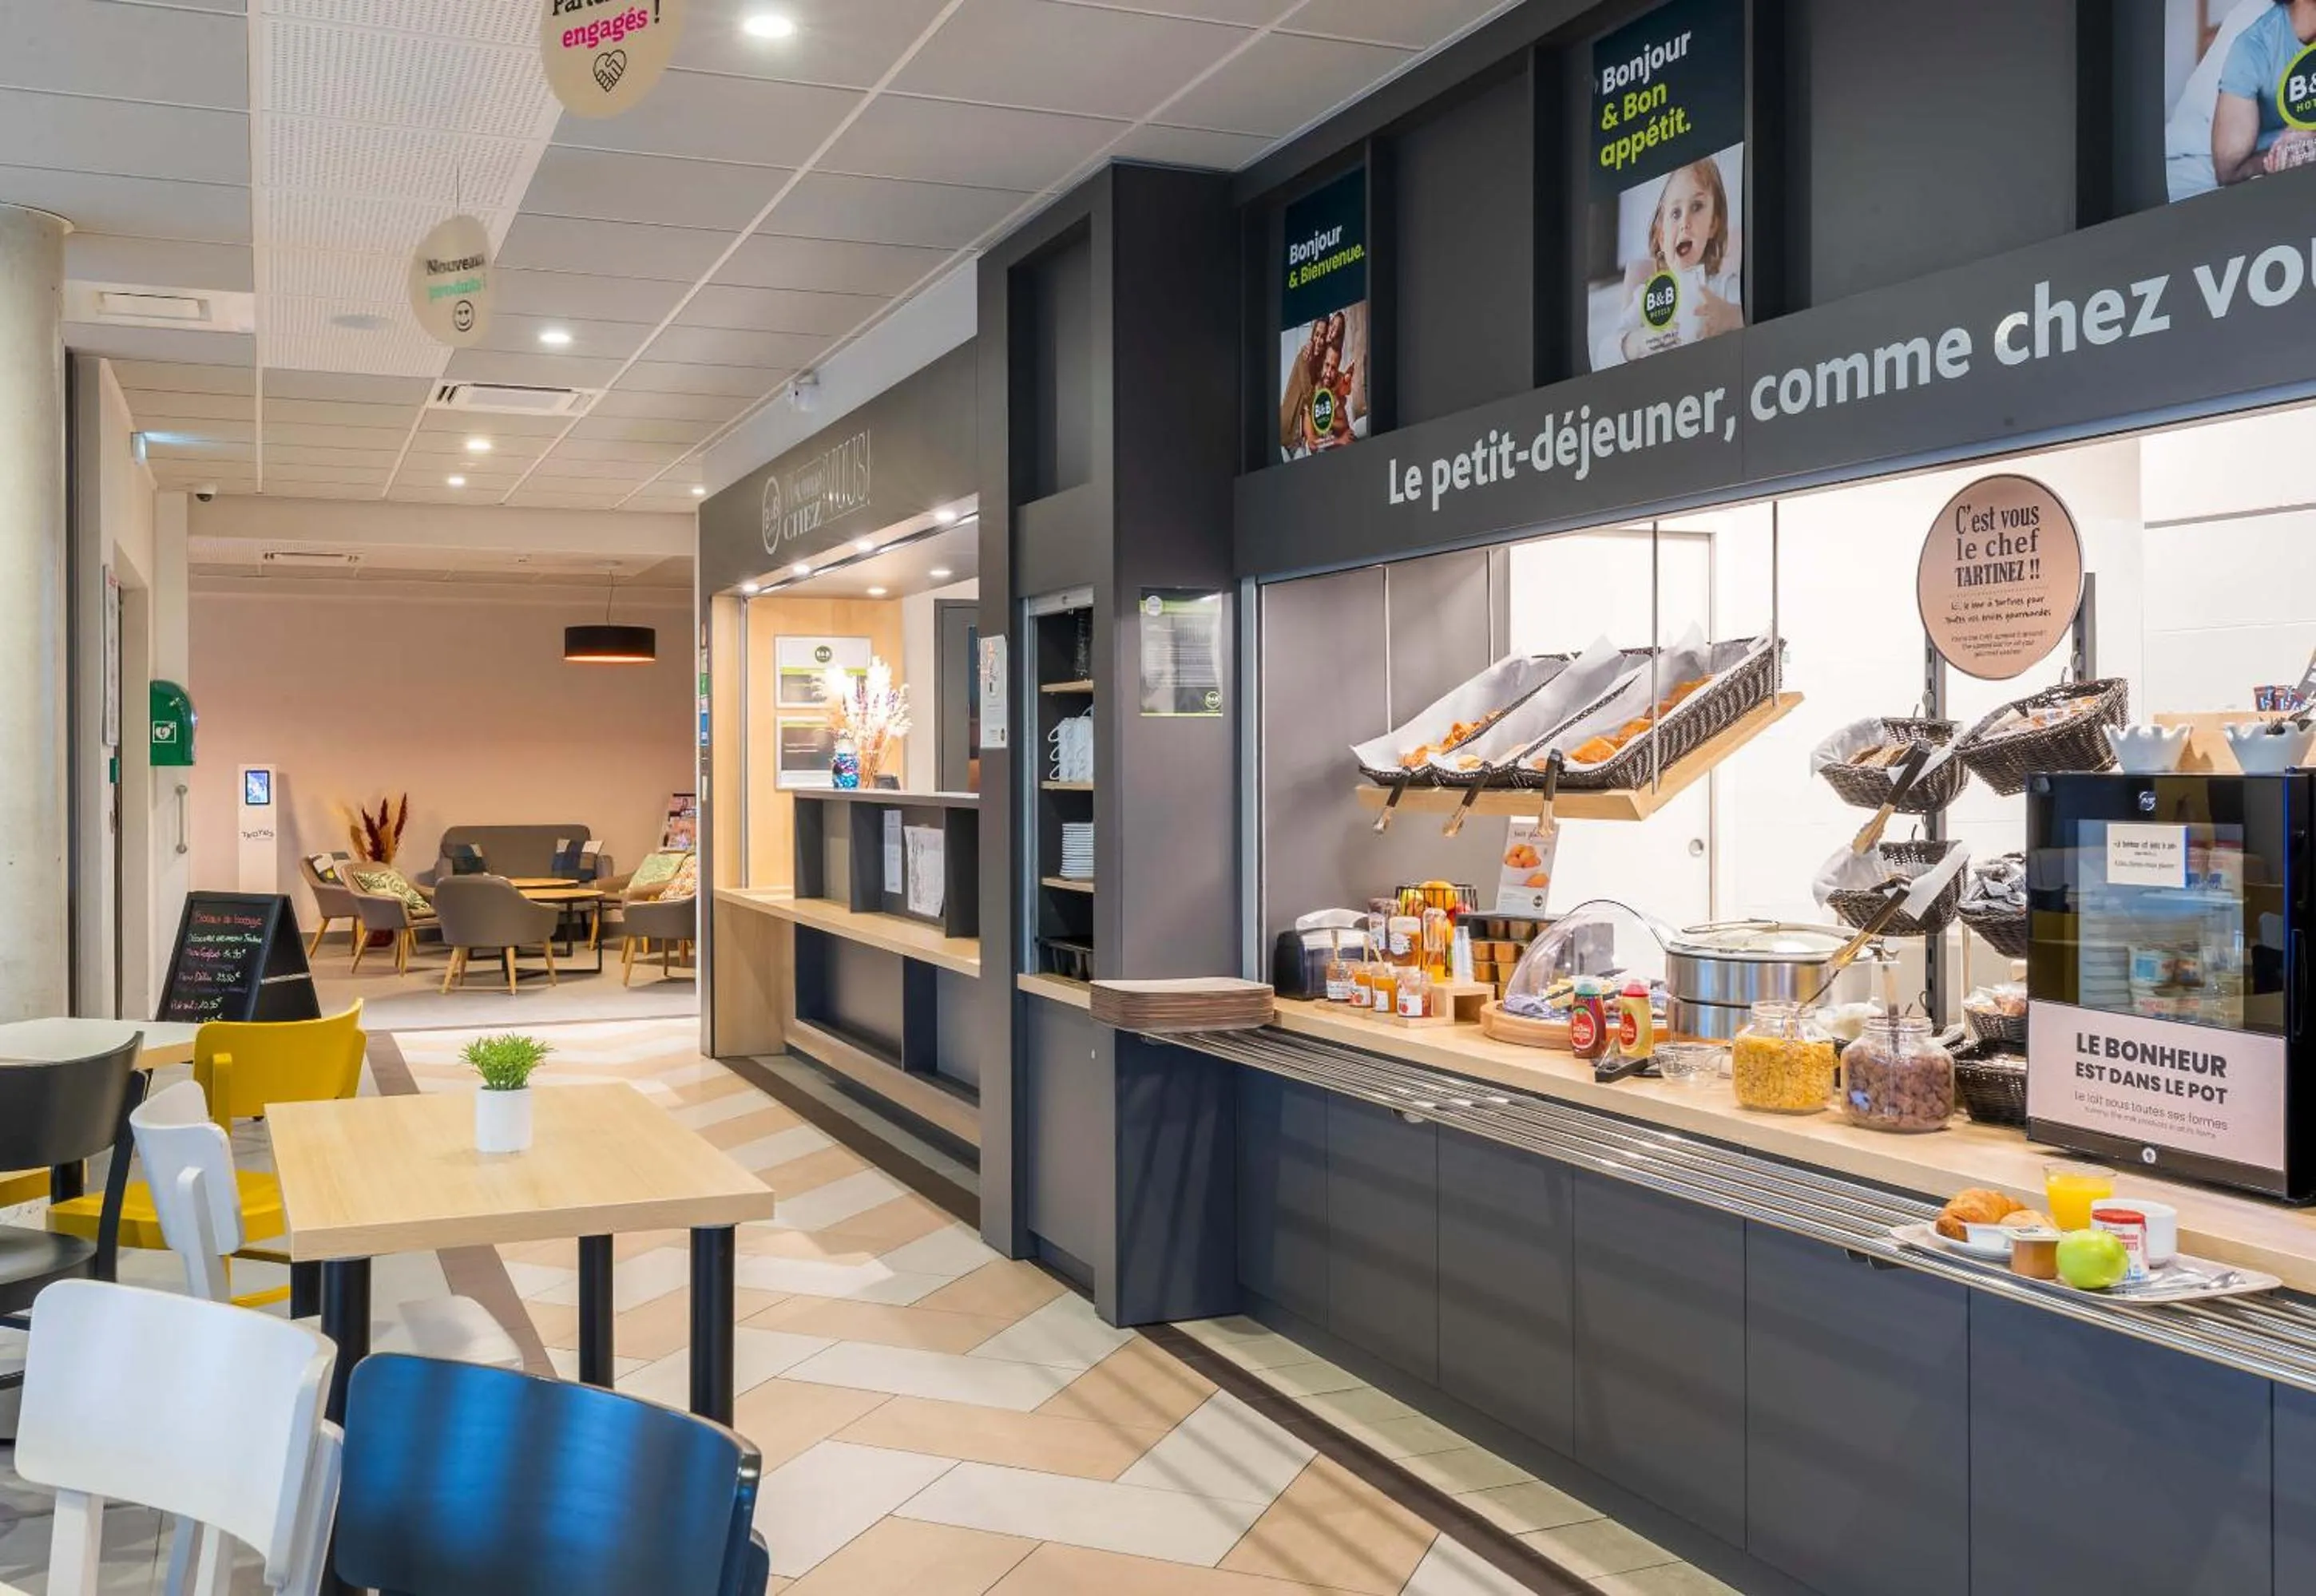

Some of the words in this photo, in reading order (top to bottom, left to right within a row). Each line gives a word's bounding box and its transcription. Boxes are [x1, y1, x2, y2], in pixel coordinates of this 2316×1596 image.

[562, 6, 648, 48] engagés
[1602, 30, 1691, 96] Bonjour
[1601, 102, 1619, 130] &
[1624, 82, 1667, 121] Bon
[1600, 107, 1691, 170] appétit.
[1288, 271, 1299, 288] &
[1300, 244, 1365, 284] Bienvenue.
[1290, 225, 1342, 265] Bonjour
[1647, 287, 1675, 311] B&B
[1389, 459, 1422, 505] Le
[1432, 386, 1737, 512] petit-déjeuner,
[1751, 327, 1973, 422] comme
[1994, 274, 2171, 366] chez
[2193, 237, 2316, 319] vo
[1956, 505, 1995, 535] C'est
[2001, 505, 2040, 529] vous
[1957, 538, 1977, 560] le
[1985, 528, 2040, 557] chef
[1955, 560, 2025, 588] TARTINEZ
[2027, 596, 2044, 608] pour
[2076, 1032, 2100, 1055] LE
[2105, 1036, 2227, 1078] BONHEUR
[2076, 1060, 2106, 1081] EST
[2109, 1067, 2161, 1091] DANS
[2166, 1078, 2184, 1096] LE
[2188, 1083, 2228, 1104] POT
[2087, 1091, 2104, 1106] lait
[2132, 1103, 2165, 1118] toutes
[2167, 1111, 2186, 1123] ses
[2188, 1112, 2228, 1131] formes
